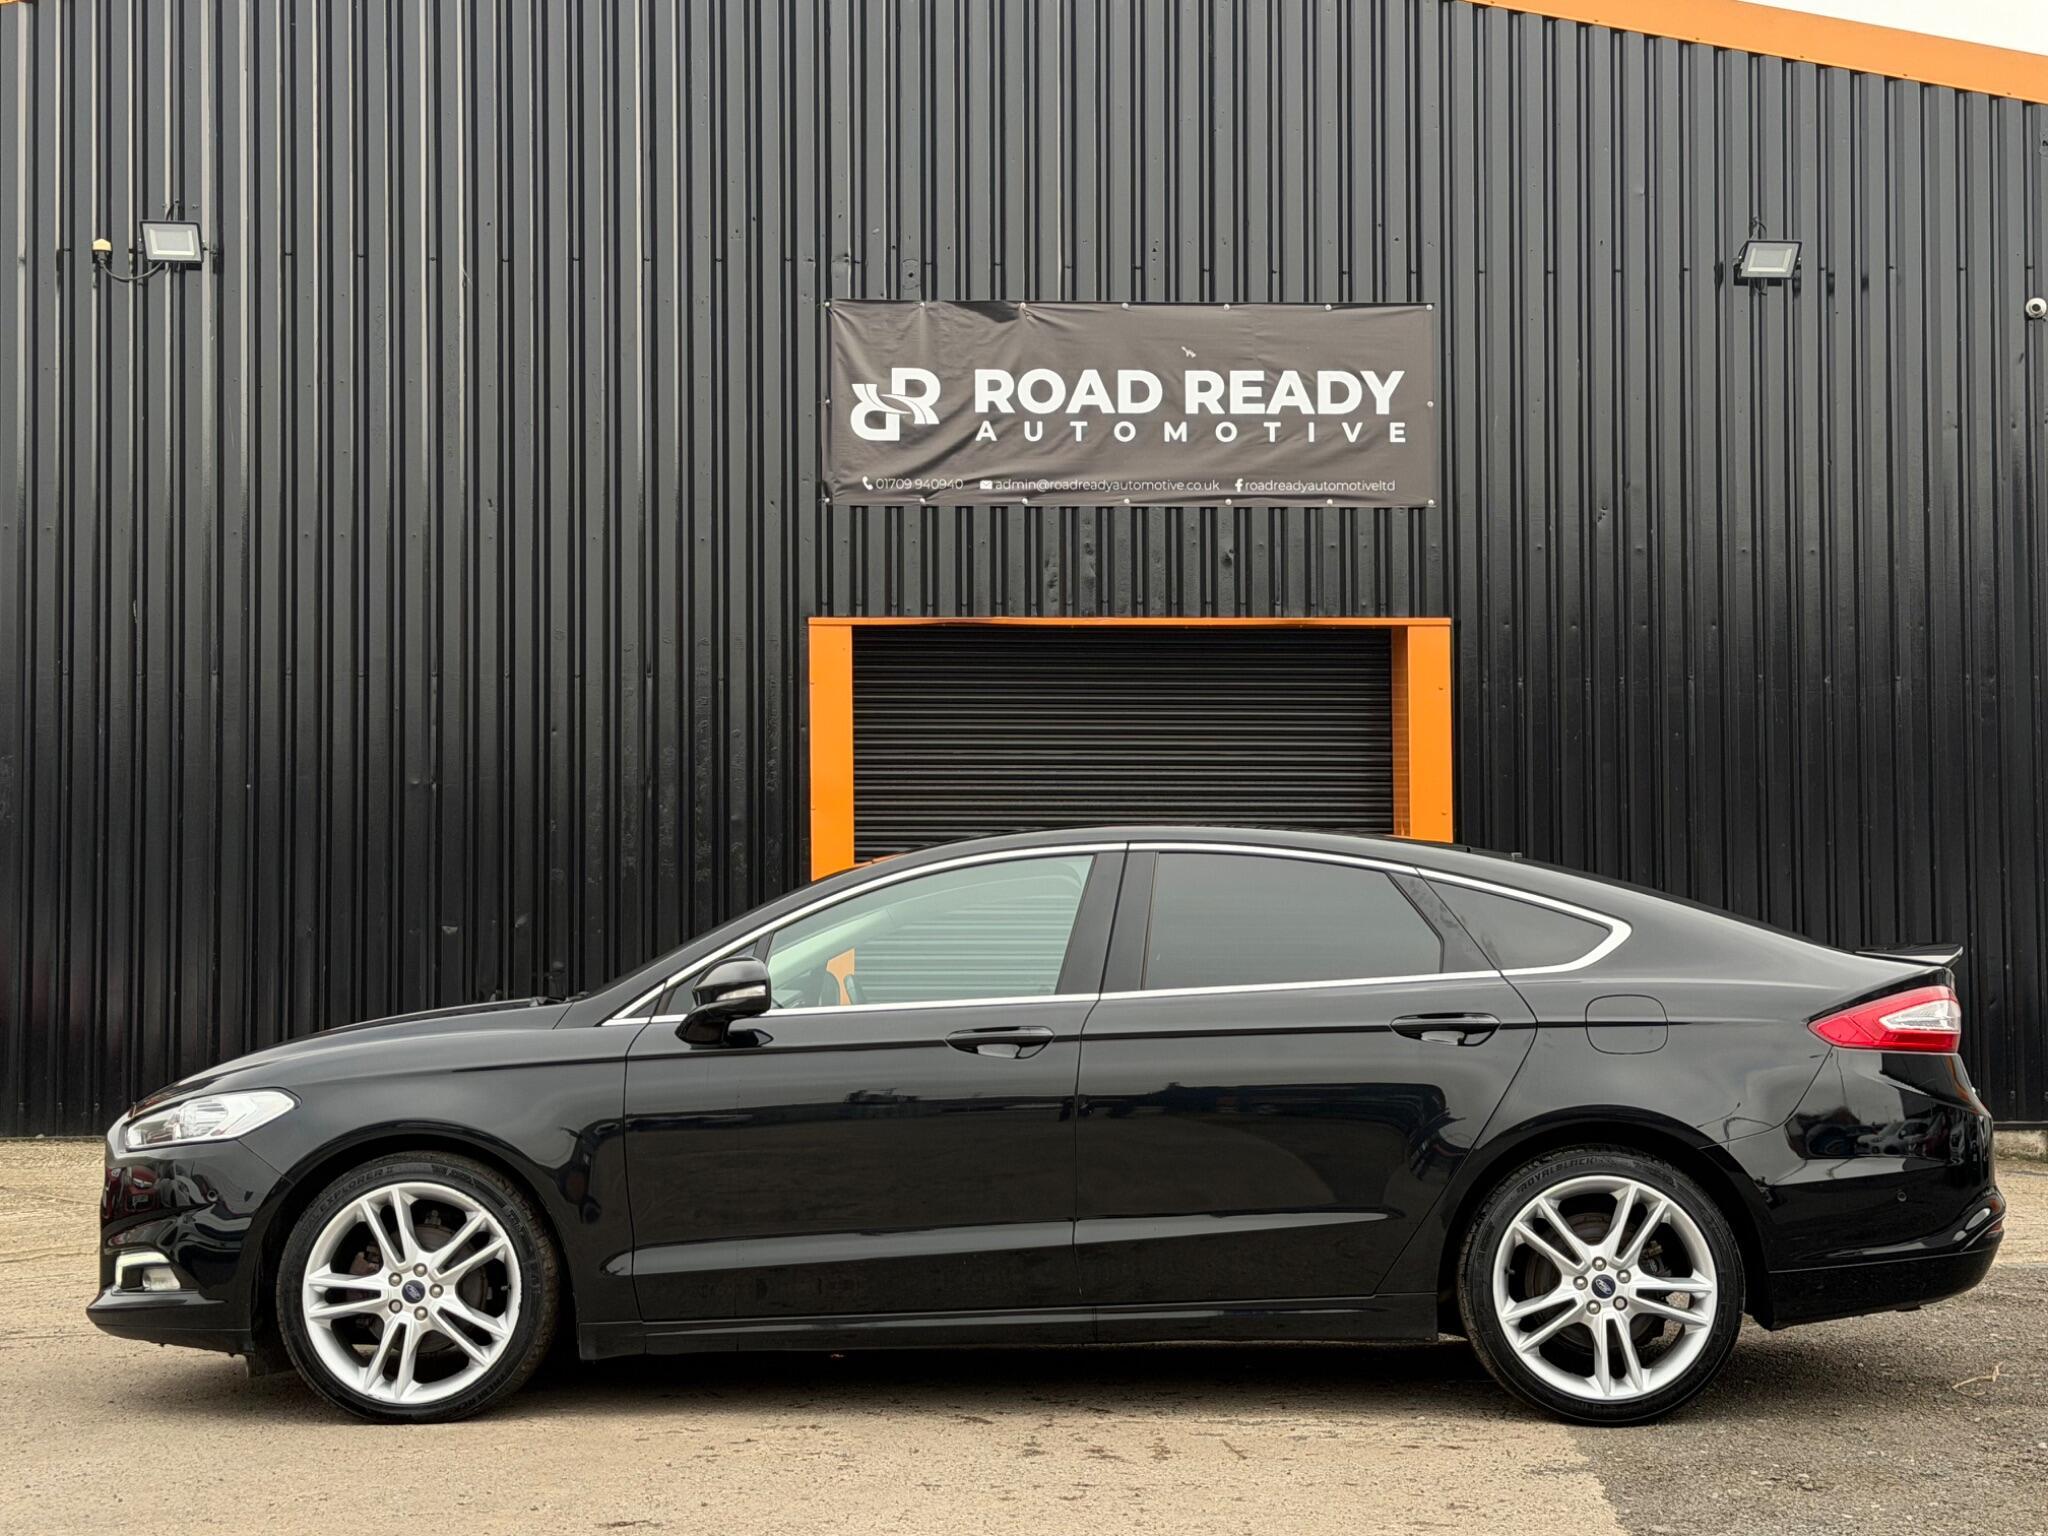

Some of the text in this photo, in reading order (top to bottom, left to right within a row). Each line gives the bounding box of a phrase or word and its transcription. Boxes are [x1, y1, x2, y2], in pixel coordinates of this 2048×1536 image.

[974, 368, 1406, 415] ROAD READY
[975, 420, 1406, 443] AUTOMOTIVE
[875, 478, 964, 490] 01709 940940
[995, 479, 1220, 493] admin@roadreadyautomotive.co.uk
